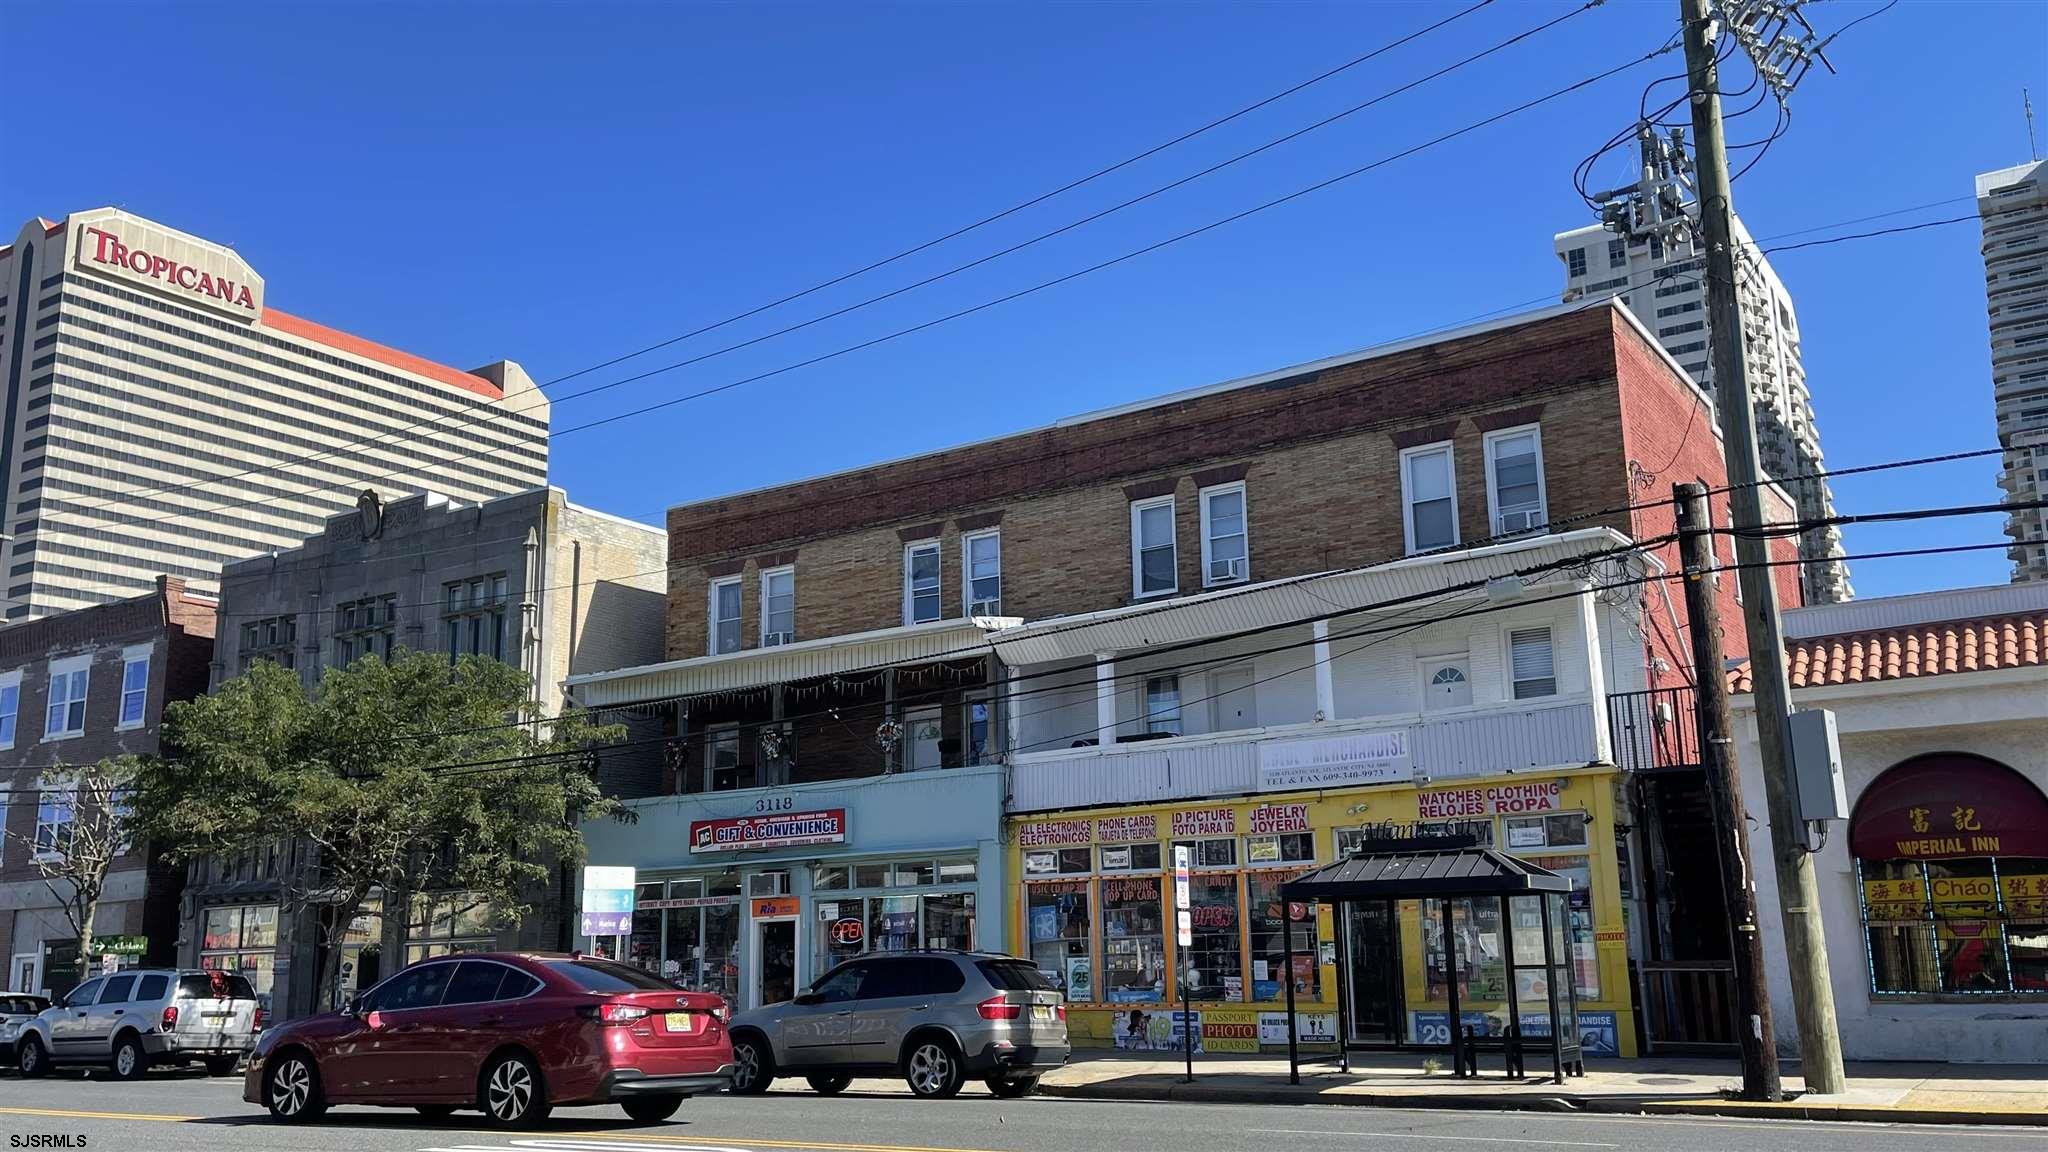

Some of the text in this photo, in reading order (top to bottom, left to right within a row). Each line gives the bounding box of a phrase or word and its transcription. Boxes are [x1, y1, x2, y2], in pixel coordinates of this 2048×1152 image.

[86, 226, 256, 310] TROPICANA
[1266, 778, 1283, 786] TEL
[1300, 774, 1320, 784] FAX
[1418, 783, 1559, 806] WATCHES CLOTHING
[755, 797, 793, 812] 3118
[1419, 798, 1552, 818] RELOJES ROPA
[1171, 809, 1233, 823] ID PICTURE
[1250, 805, 1307, 821] JEWELRY
[1019, 819, 1092, 835] ALL ELECTRONICS
[1098, 815, 1156, 830] PHONE CARDS
[1172, 821, 1234, 835] FOTO PARA ID
[1250, 818, 1307, 834] JOYERIA
[1359, 817, 1436, 840] Atlantic
[699, 832, 711, 844] AC
[716, 827, 741, 842] GIFT
[744, 825, 755, 839] &
[755, 818, 838, 838] CONVENIENCE
[1020, 832, 1090, 846] ELECTRONICOS
[1896, 836, 2000, 856] IMPERIAL INN
[1933, 879, 1991, 897] Cháo
[759, 902, 777, 915] Ria
[1206, 1012, 1252, 1022] PASSPORT
[1207, 1024, 1253, 1037] PHOTO
[1422, 1024, 1450, 1044] 29
[1207, 1040, 1255, 1050] ID CARDS
